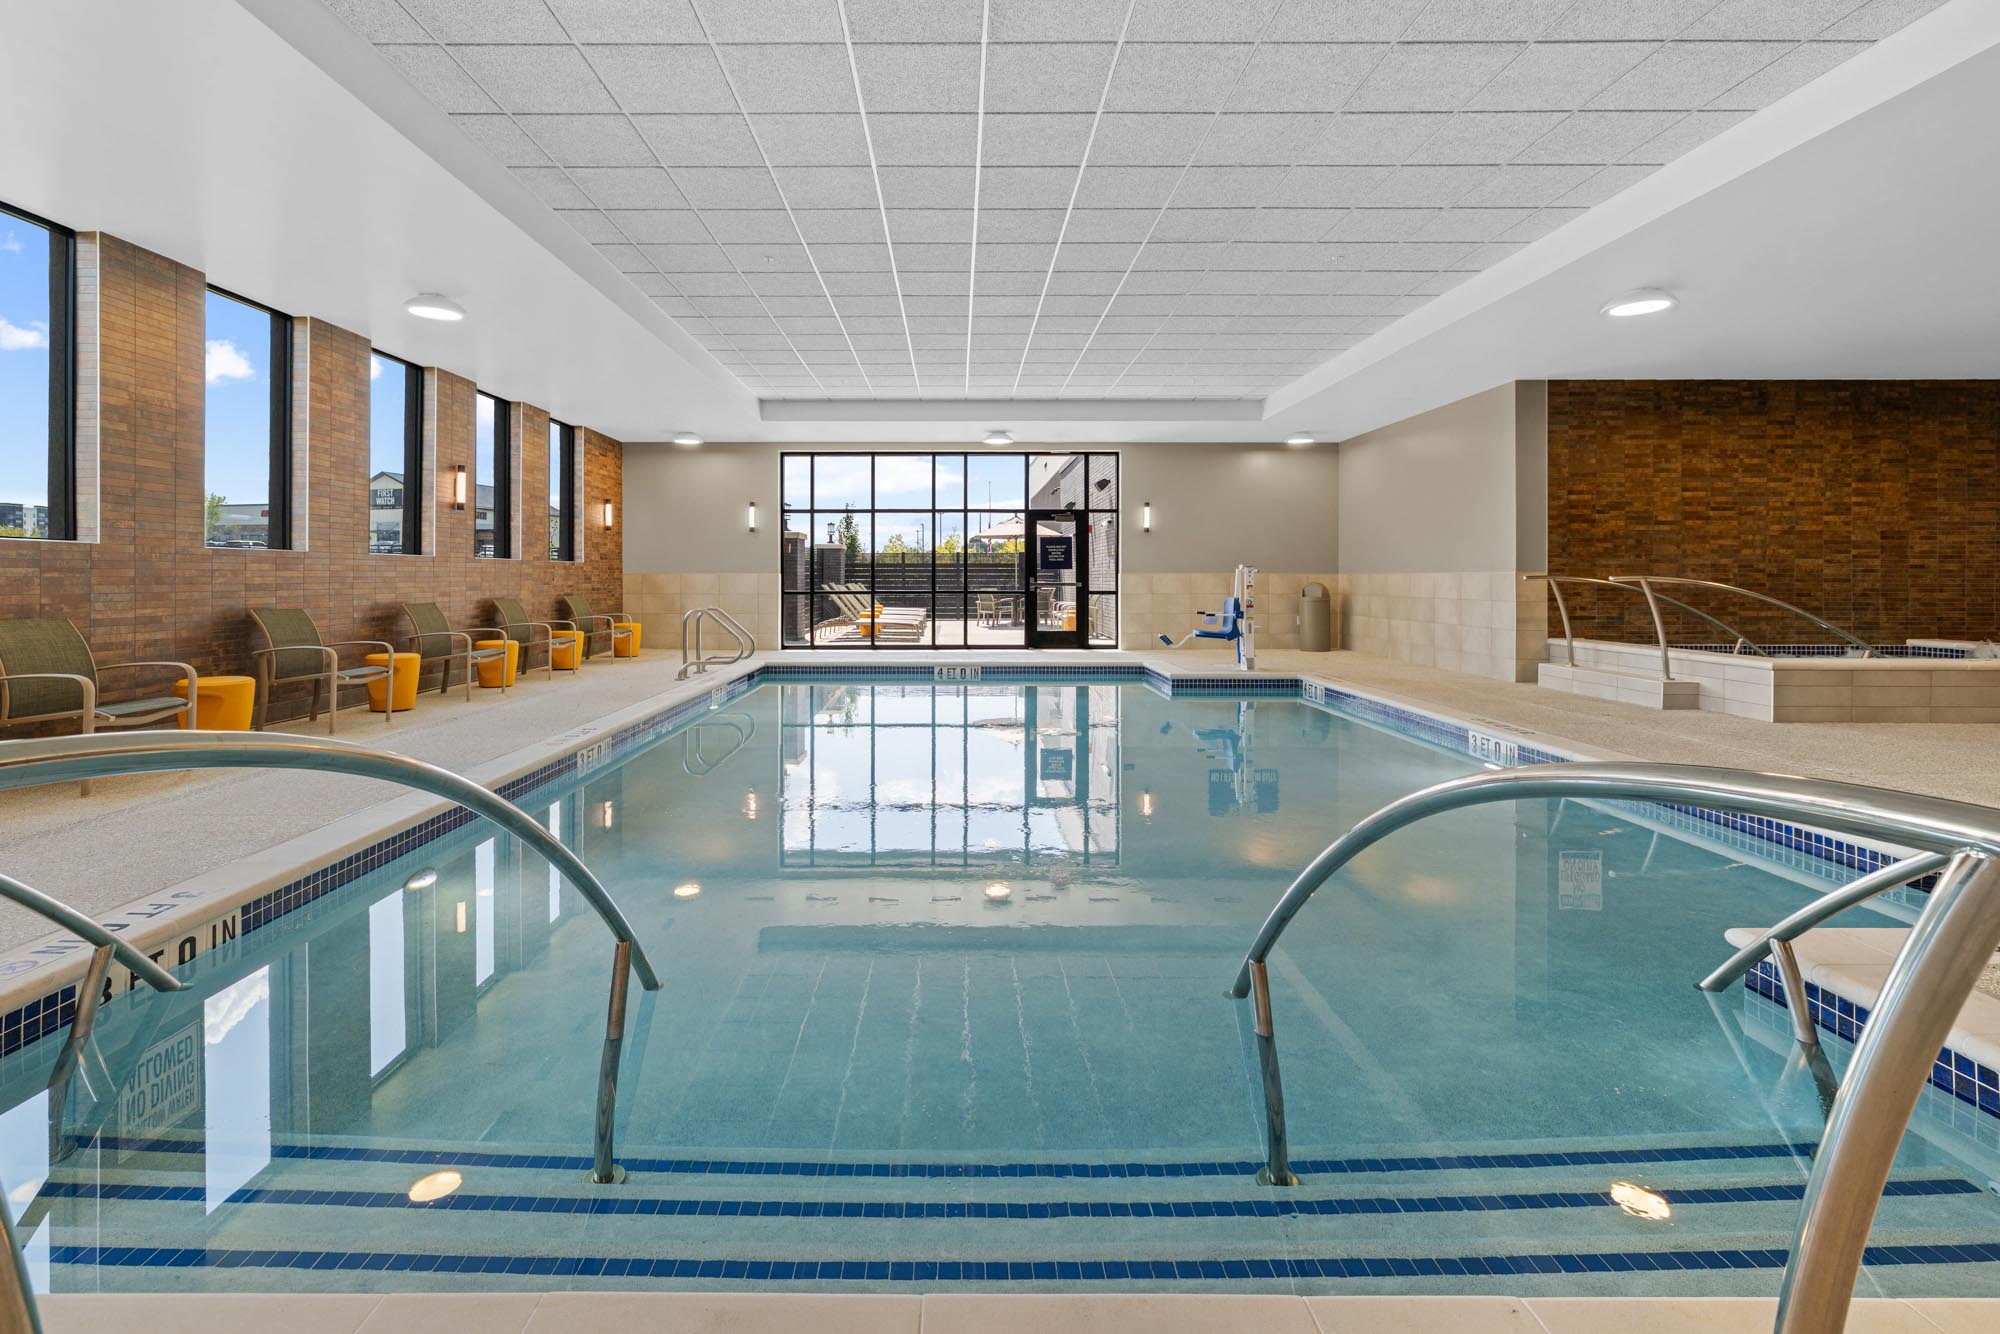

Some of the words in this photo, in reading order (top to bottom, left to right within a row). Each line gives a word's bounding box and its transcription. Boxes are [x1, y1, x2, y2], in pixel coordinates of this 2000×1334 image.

[377, 489, 393, 497] FIRST
[376, 497, 395, 505] WATCH
[937, 667, 943, 679] 4
[960, 667, 967, 679] 0
[970, 667, 979, 680] IN
[1471, 734, 1477, 753] 3
[1494, 741, 1501, 761] 0
[1505, 744, 1515, 766] IN
[170, 890, 204, 899] 3
[127, 903, 179, 918] FT
[30, 939, 88, 955] IN
[178, 936, 196, 965] 0
[212, 915, 236, 949] IN
